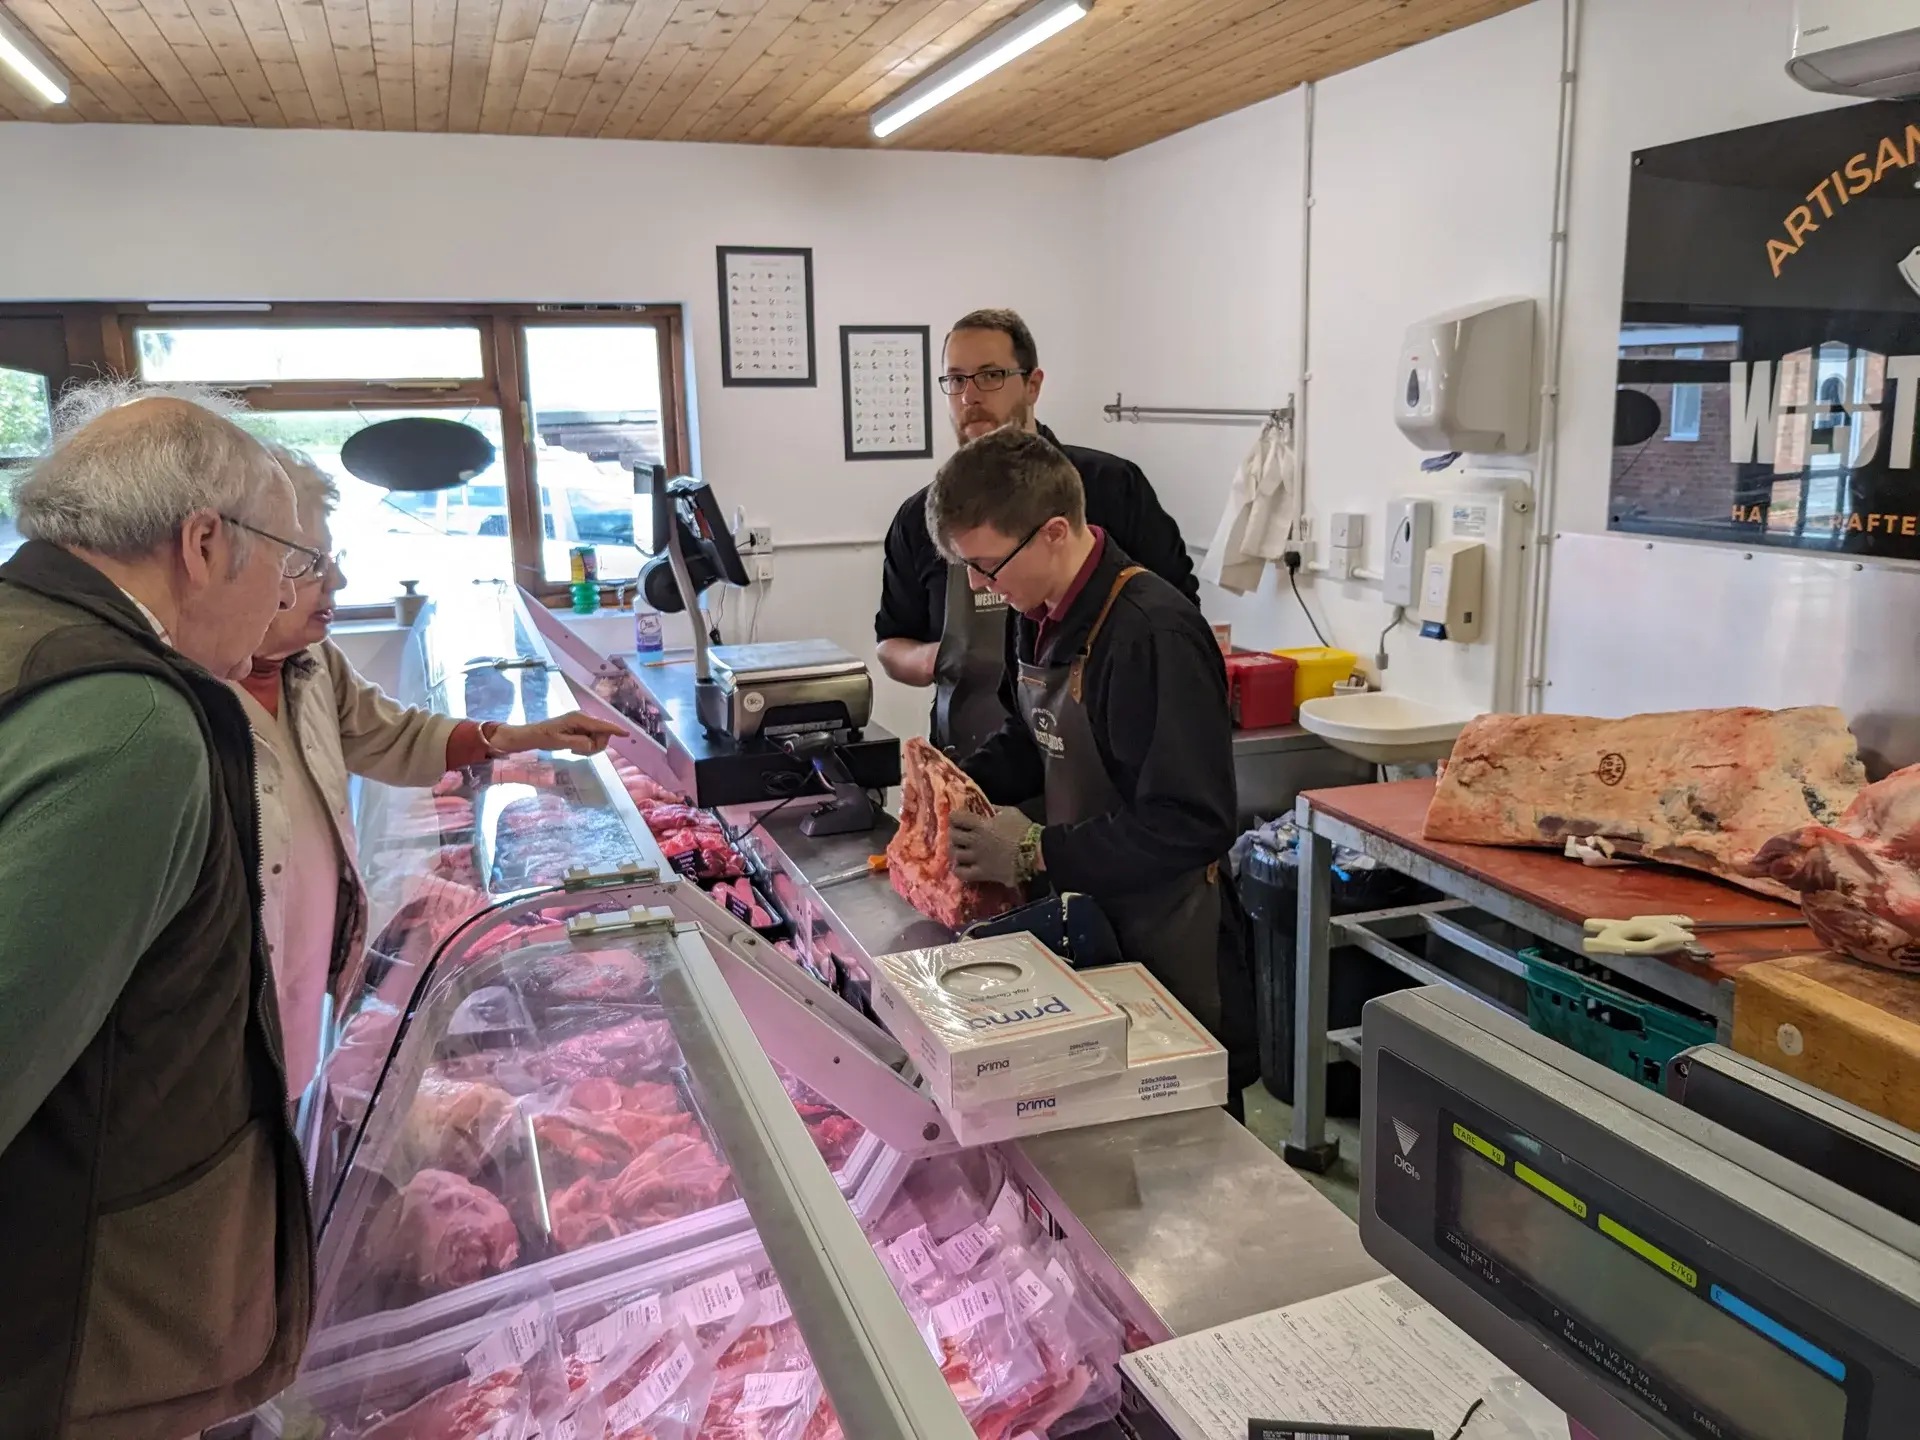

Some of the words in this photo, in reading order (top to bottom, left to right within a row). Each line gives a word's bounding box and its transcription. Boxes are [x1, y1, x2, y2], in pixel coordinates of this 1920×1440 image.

[970, 996, 1071, 1029] prima
[977, 1060, 1010, 1076] prima
[1017, 1098, 1056, 1116] prima
[1457, 1128, 1476, 1146] TARE
[1492, 1149, 1501, 1161] kg
[1394, 1155, 1416, 1178] DIGI
[1573, 1200, 1583, 1214] kg
[1446, 1232, 1466, 1251] ZERO
[1460, 1251, 1475, 1267] NET
[1483, 1268, 1494, 1282] FIX
[1671, 1261, 1693, 1284] £/kg
[1566, 1318, 1575, 1331] M
[1594, 1338, 1604, 1352] V1
[1608, 1348, 1620, 1364] V2
[1623, 1359, 1635, 1374] V3
[1693, 1411, 1722, 1438] LABEL
